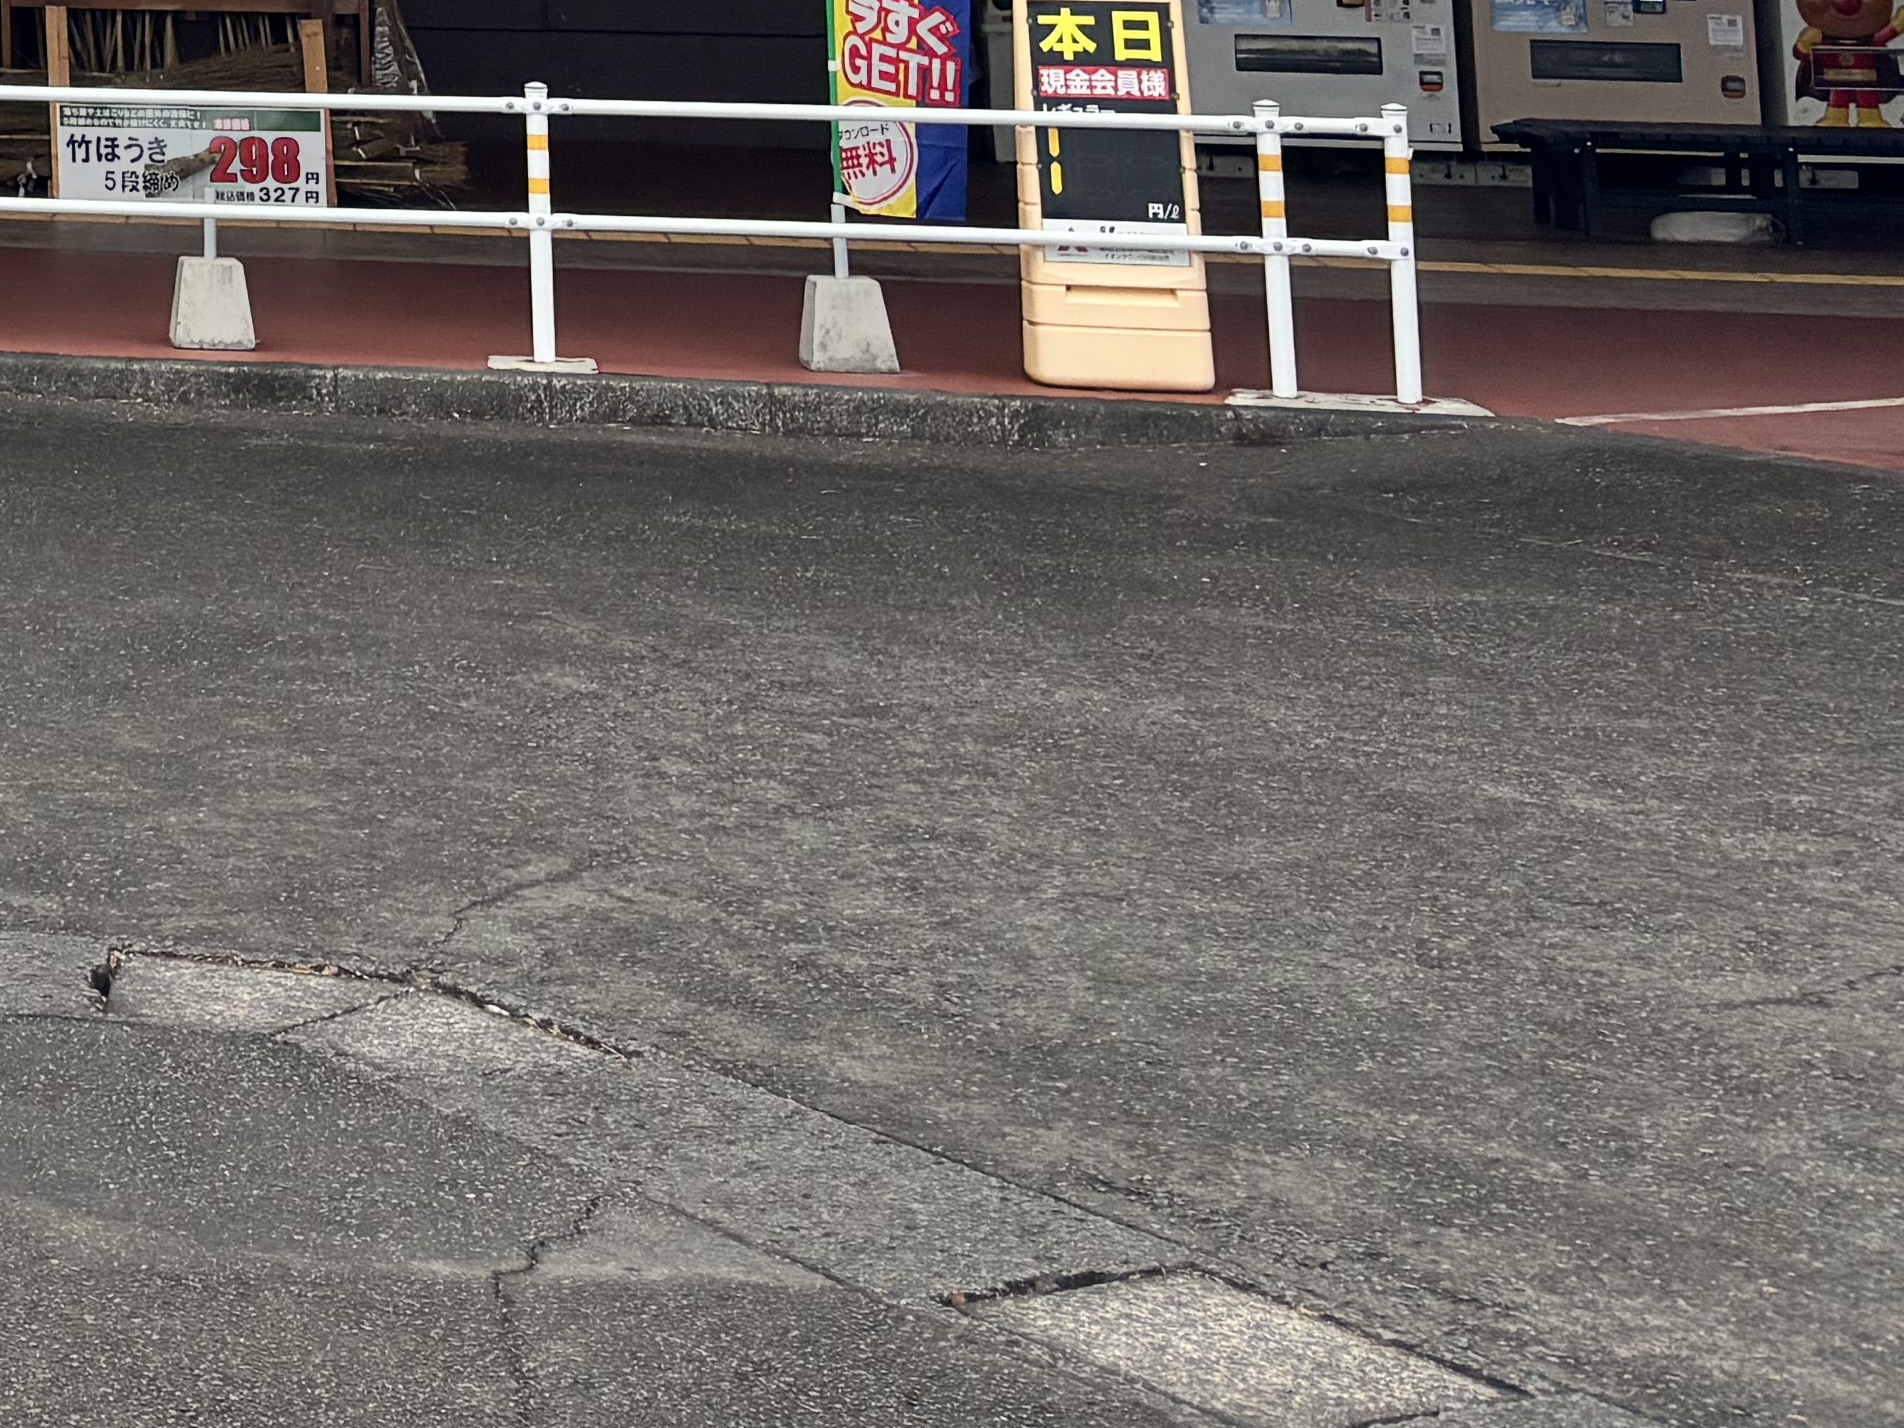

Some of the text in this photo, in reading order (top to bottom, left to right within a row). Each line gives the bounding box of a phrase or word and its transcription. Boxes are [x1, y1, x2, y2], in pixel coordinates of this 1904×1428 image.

[1036, 7, 1162, 62] 本日
[1039, 68, 1167, 97] 現金会員様
[66, 133, 168, 165] 竹ほうき
[841, 138, 897, 181] 無料
